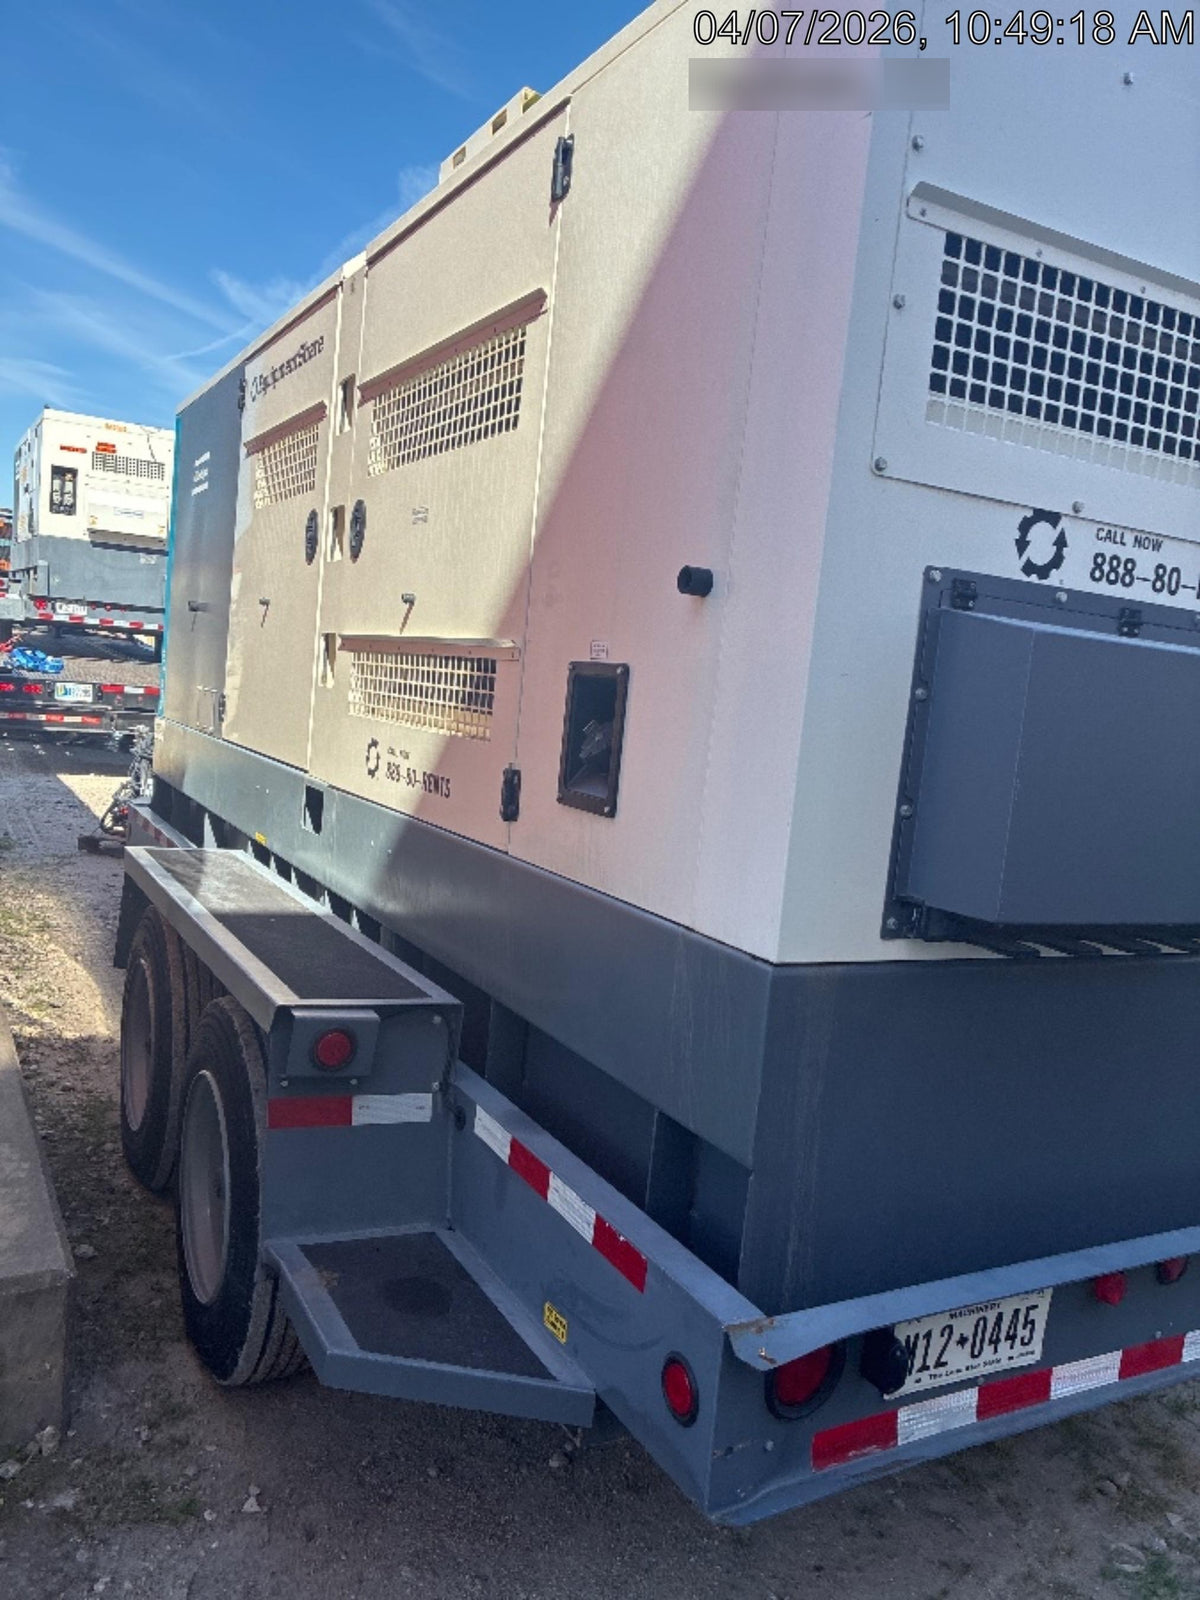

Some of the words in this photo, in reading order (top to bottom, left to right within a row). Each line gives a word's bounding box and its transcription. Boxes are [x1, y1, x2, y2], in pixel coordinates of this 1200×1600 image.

[1096, 527, 1126, 546] CALL
[1133, 535, 1164, 553] NOW
[1089, 552, 1200, 600] 888-80-
